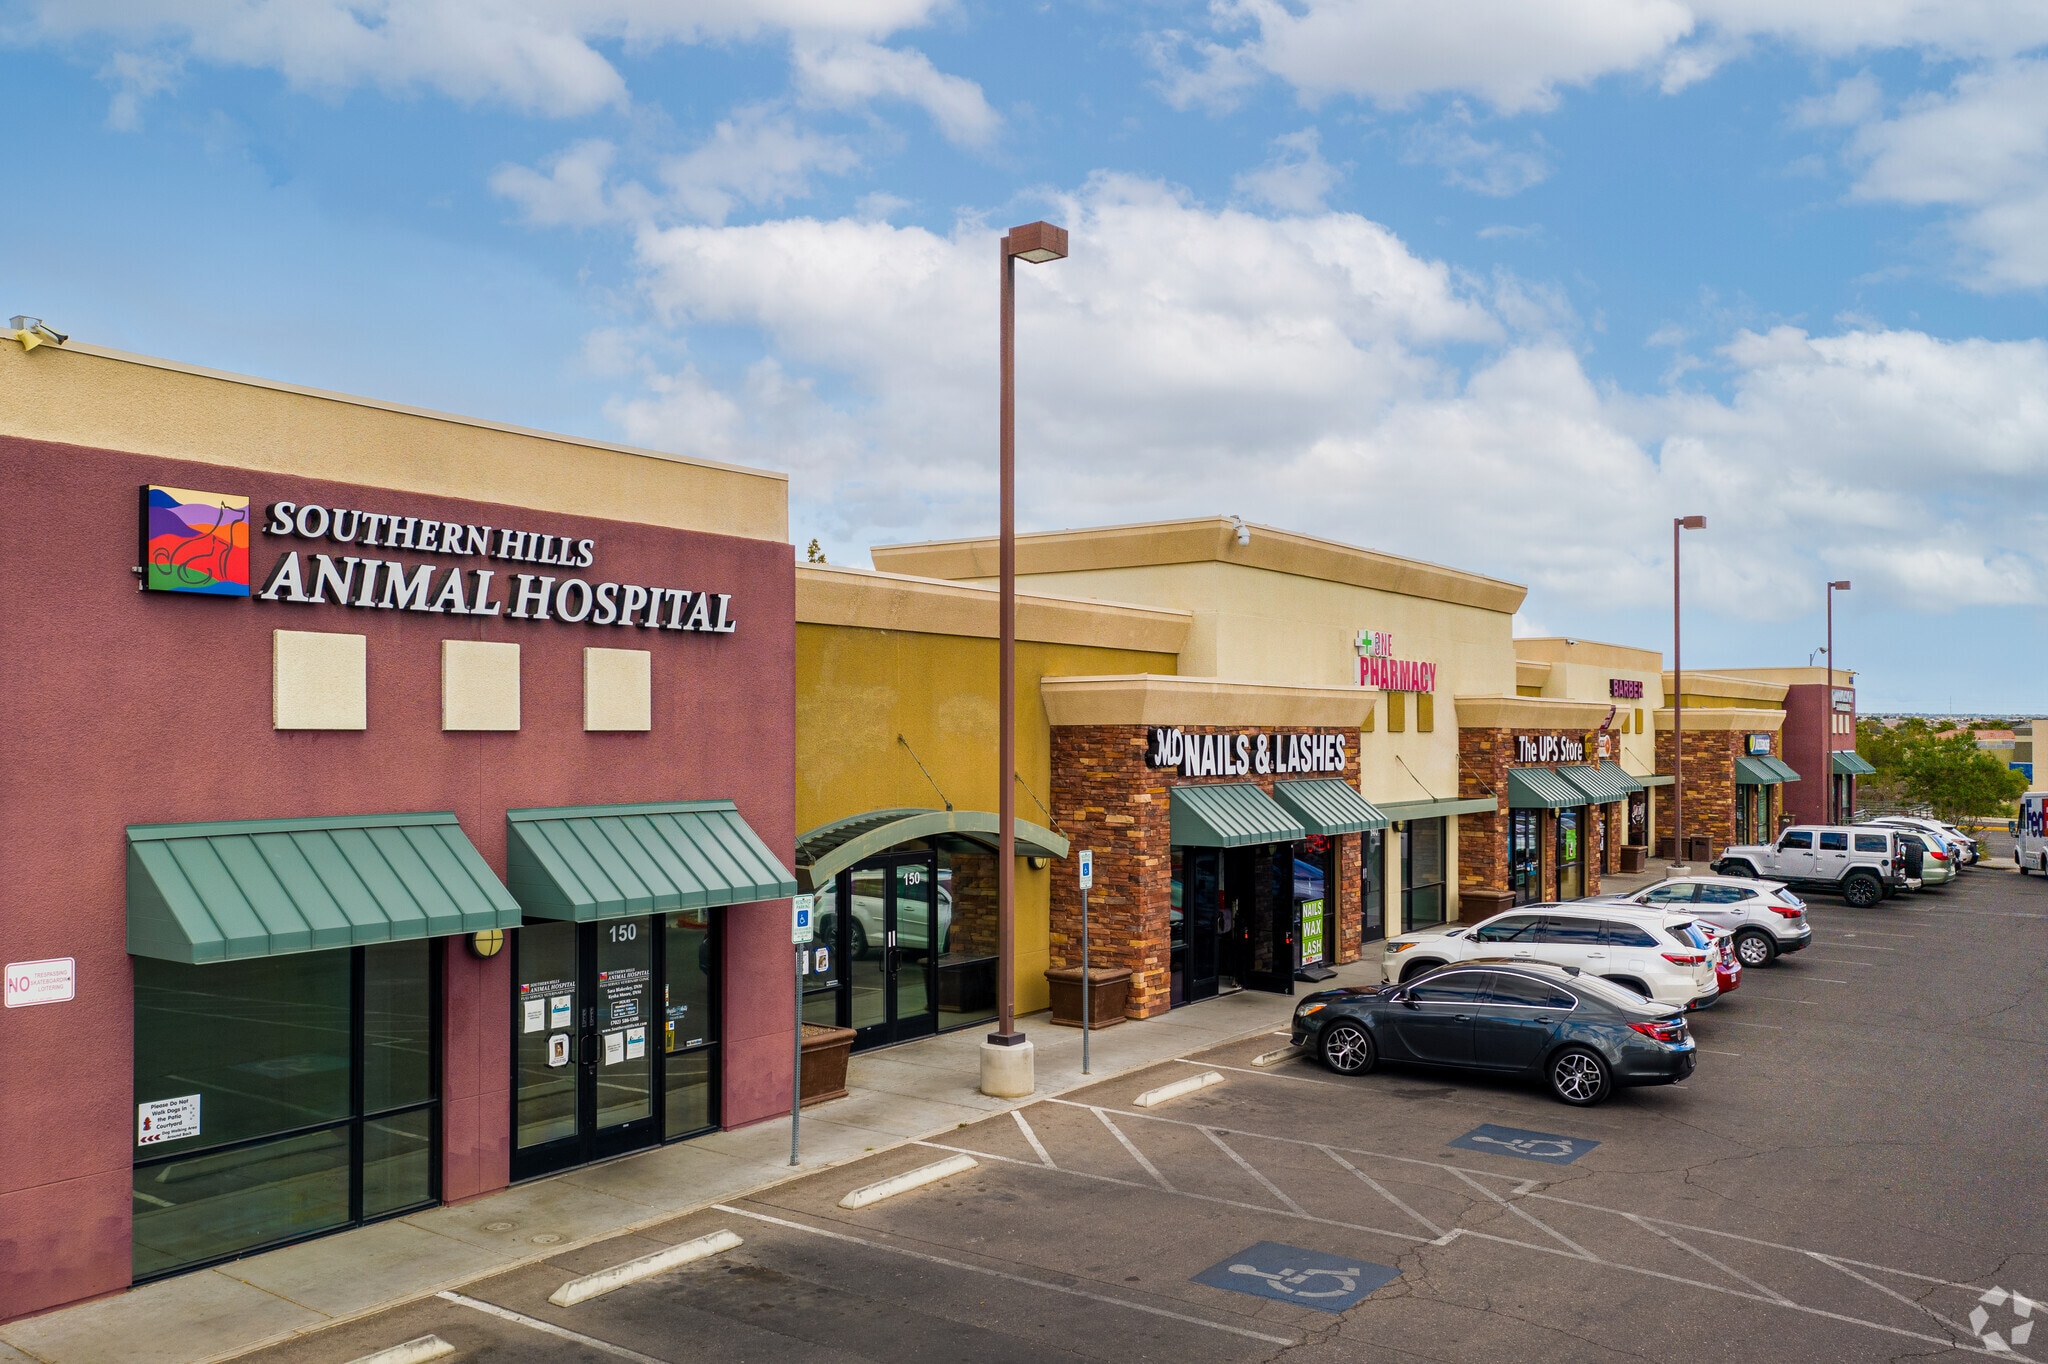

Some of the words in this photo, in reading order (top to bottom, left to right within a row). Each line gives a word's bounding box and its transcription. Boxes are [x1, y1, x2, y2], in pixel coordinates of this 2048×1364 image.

[268, 501, 492, 556] SOUTHERN
[496, 528, 595, 568] HILLS
[259, 551, 501, 616] ANIMAL
[509, 573, 737, 633] HOSPITAL
[1360, 656, 1437, 692] PHARMACY
[1184, 734, 1250, 777] NAILS
[1255, 733, 1272, 775] &
[1276, 733, 1347, 774] LASHES
[1518, 735, 1538, 762] The
[1540, 735, 1559, 762] UPS
[1560, 735, 1584, 762] Store
[903, 871, 920, 886] 150
[1302, 901, 1322, 918] NAILS
[609, 923, 637, 943] 150
[1303, 919, 1321, 938] WAX
[1302, 938, 1322, 957] LASH
[34, 969, 68, 979] TRESPASSING
[9, 976, 30, 994] NO
[31, 977, 70, 986] SKATEBOARDIN
[38, 984, 64, 993] LOITERING
[530, 985, 550, 993] ANIMAL
[156, 1120, 183, 1130] Courtyard
